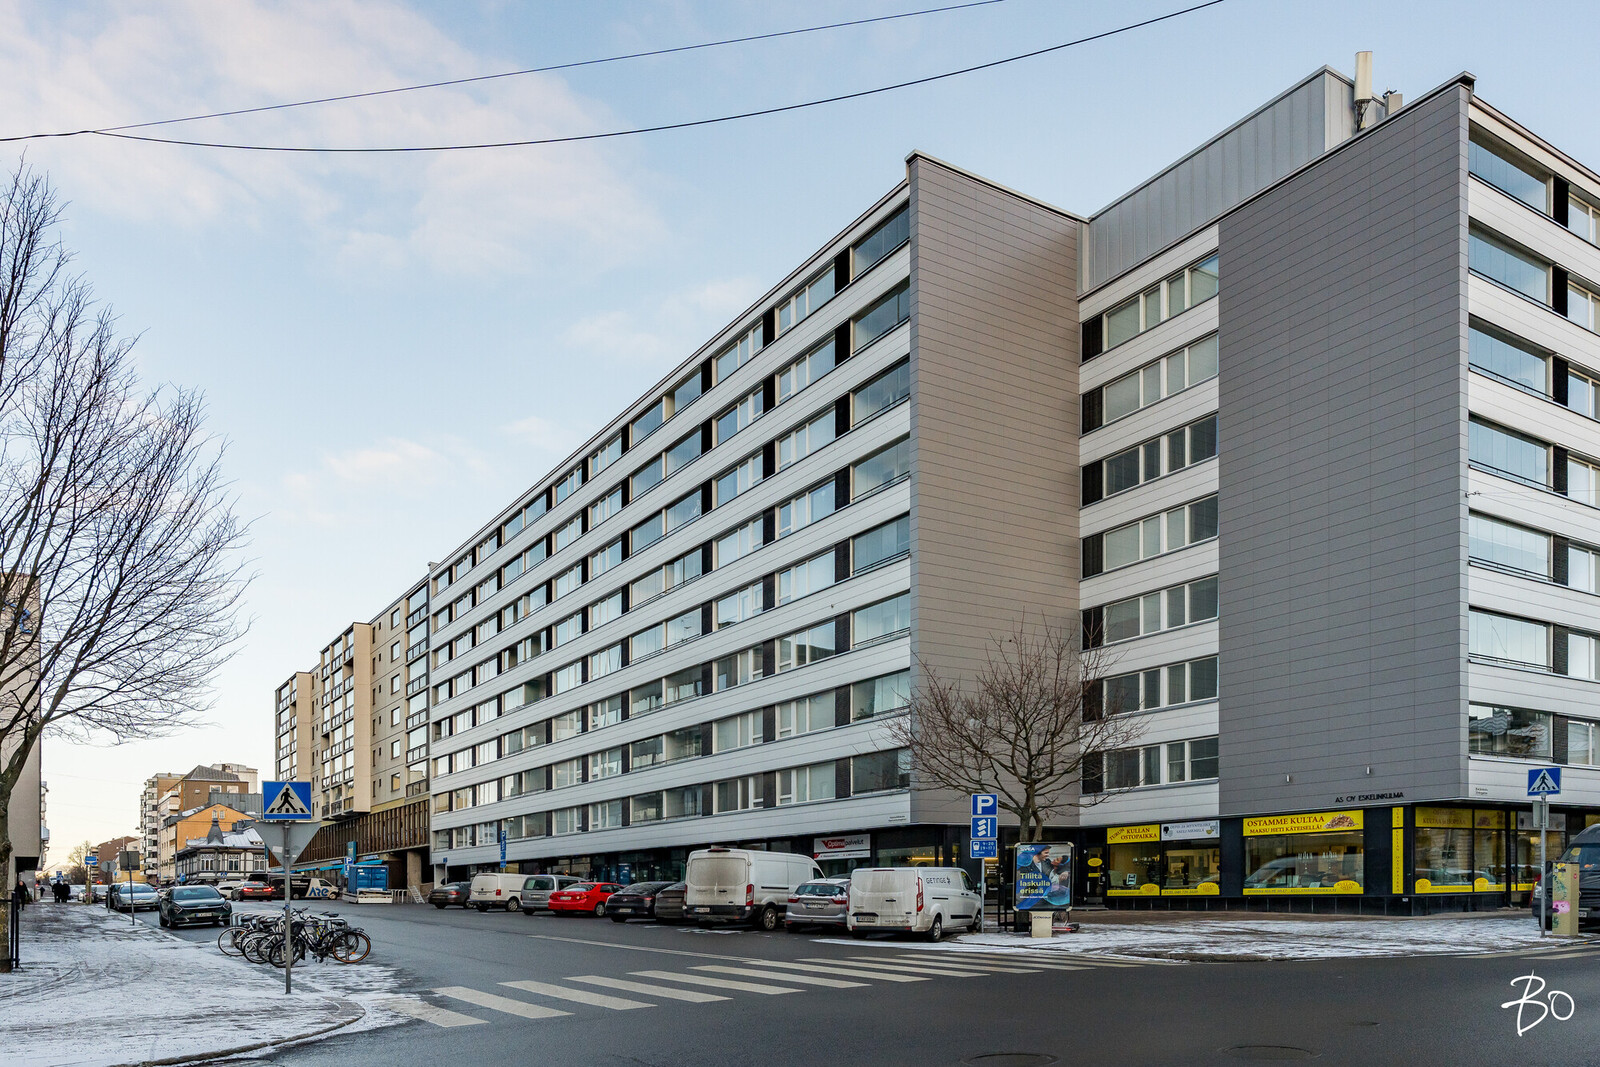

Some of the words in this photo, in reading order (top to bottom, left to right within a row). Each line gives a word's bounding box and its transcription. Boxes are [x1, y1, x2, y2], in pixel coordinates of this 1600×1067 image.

[1358, 792, 1404, 801] ESKELINKULMA
[977, 795, 994, 814] P
[1247, 817, 1289, 827] OSTAMME
[1290, 815, 1325, 824] KULTAA
[1109, 828, 1125, 840] TURUN
